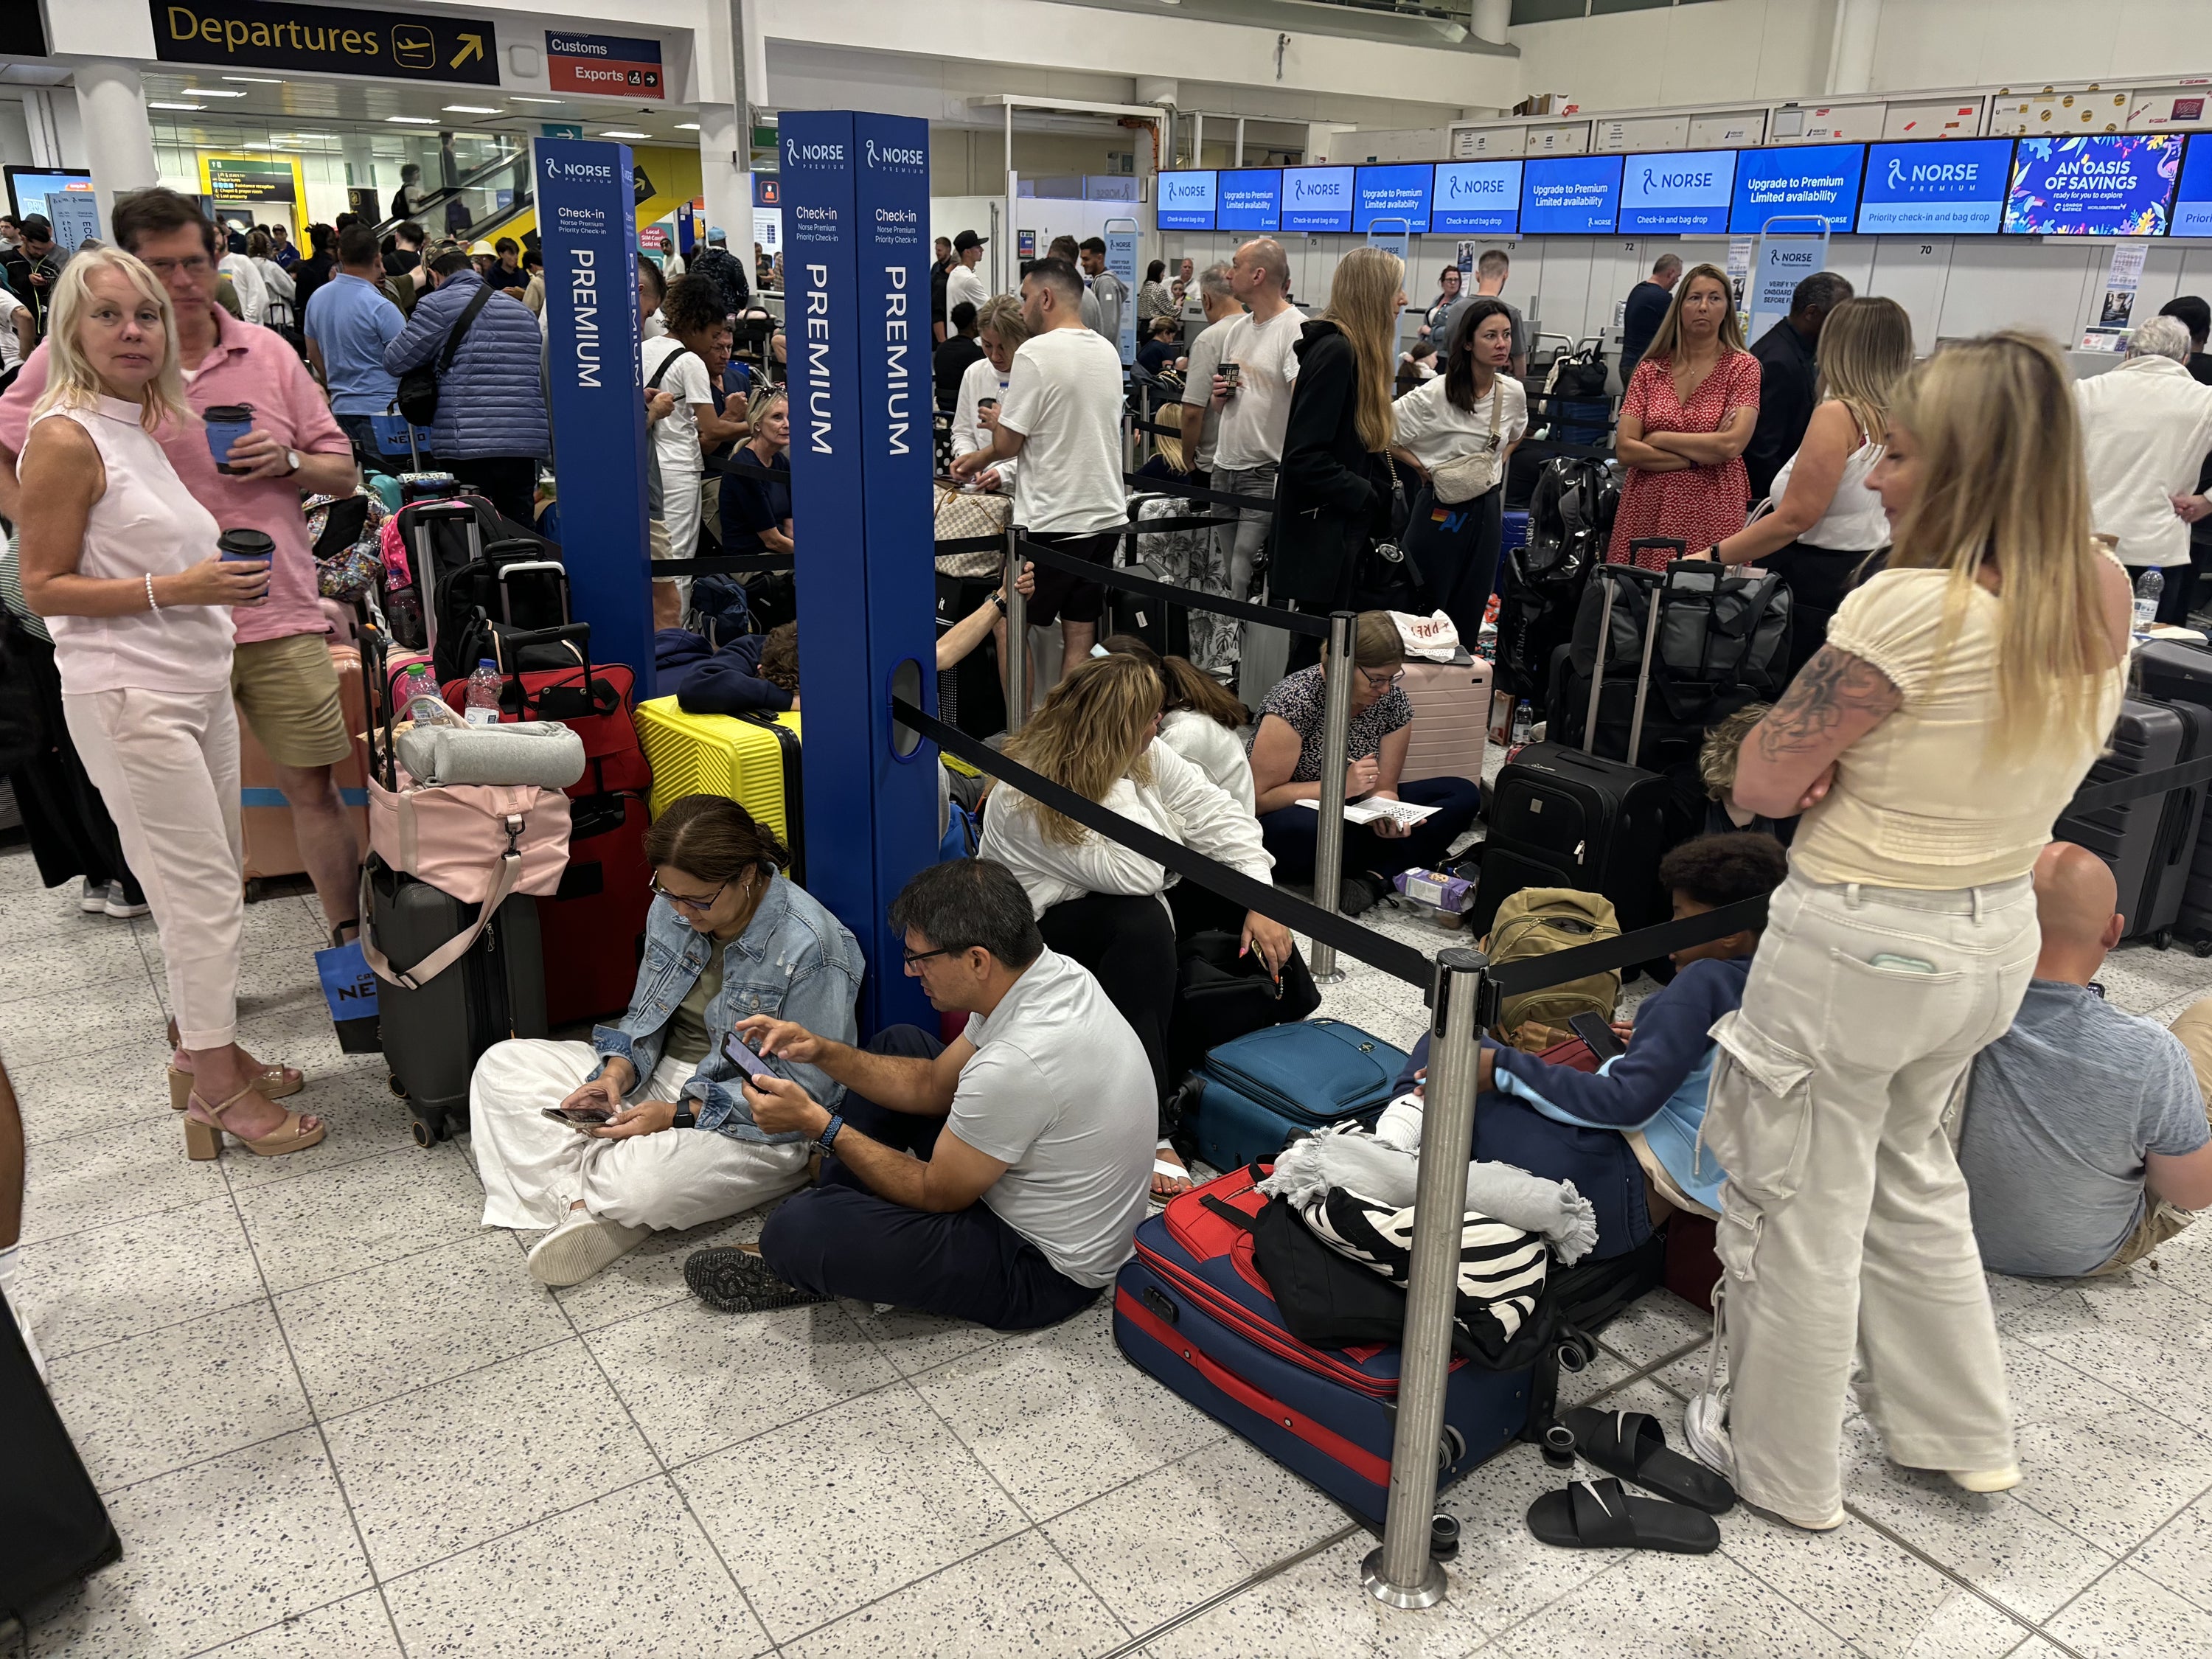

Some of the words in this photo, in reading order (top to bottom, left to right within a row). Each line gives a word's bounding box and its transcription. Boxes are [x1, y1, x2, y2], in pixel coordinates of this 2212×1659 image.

[167, 7, 379, 55] Departures
[552, 39, 608, 55] Customs
[575, 66, 624, 82] Exports
[803, 145, 844, 160] NORSE
[883, 147, 923, 164] NORSE
[565, 164, 611, 177] NORSE
[1912, 164, 1979, 182] NORSE
[2056, 162, 2079, 175] AN
[2083, 161, 2131, 175] OASIS
[1662, 173, 1712, 188] NORSE
[1748, 177, 1788, 189] Upgrade
[1790, 177, 1800, 187] to
[1801, 175, 1843, 187] Premium
[2045, 178, 2067, 190] OF
[2069, 176, 2138, 189] SAVINGS
[1179, 186, 1206, 197] NORSE
[1307, 184, 1340, 195] NORSE
[1465, 181, 1504, 193] NORSE
[1534, 184, 1564, 195] Upgrade
[1565, 185, 1573, 193] to
[1575, 184, 1607, 193] Premium
[1224, 191, 1245, 201] Upgrade
[1252, 190, 1273, 199] Premium
[1363, 189, 1388, 199] Upgrade
[1389, 189, 1395, 198] to
[1397, 188, 1422, 198] Premium
[1750, 191, 1784, 203] Limited
[1786, 190, 1837, 203] availability
[2100, 192, 2123, 200] explore
[1226, 201, 1243, 209] Limited
[1244, 201, 1270, 210] availability
[1366, 200, 1386, 209] Limited
[1388, 199, 1419, 209] availability
[1536, 196, 1562, 206] Limited
[1563, 196, 1602, 207] availability
[558, 207, 605, 219] Check-in
[796, 206, 838, 220] Check-in
[875, 209, 917, 222] Check-in
[1869, 213, 1896, 223] Priority
[1899, 212, 1933, 221] check-in
[1954, 212, 1969, 222] bag
[1970, 212, 1989, 223] drop
[1479, 218, 1490, 226] bag
[1490, 218, 1502, 226] drop
[1679, 216, 1691, 225] bag
[1692, 216, 1708, 224] drop
[814, 223, 836, 232] Premium
[894, 226, 916, 234] Premium
[796, 233, 815, 243] Priority
[815, 233, 838, 242] Check-in
[875, 236, 894, 245] Priority
[1624, 243, 1634, 251] 72
[1920, 246, 1932, 254] 70
[1781, 253, 1812, 262] NORSE
[571, 249, 602, 388] PREMIUM
[806, 264, 832, 454] PREMIUM
[886, 266, 910, 455] PREMIUM
[1526, 517, 1535, 547] OSPREY
[1516, 618, 1528, 663] OSPREY
[338, 982, 376, 1001] NE
